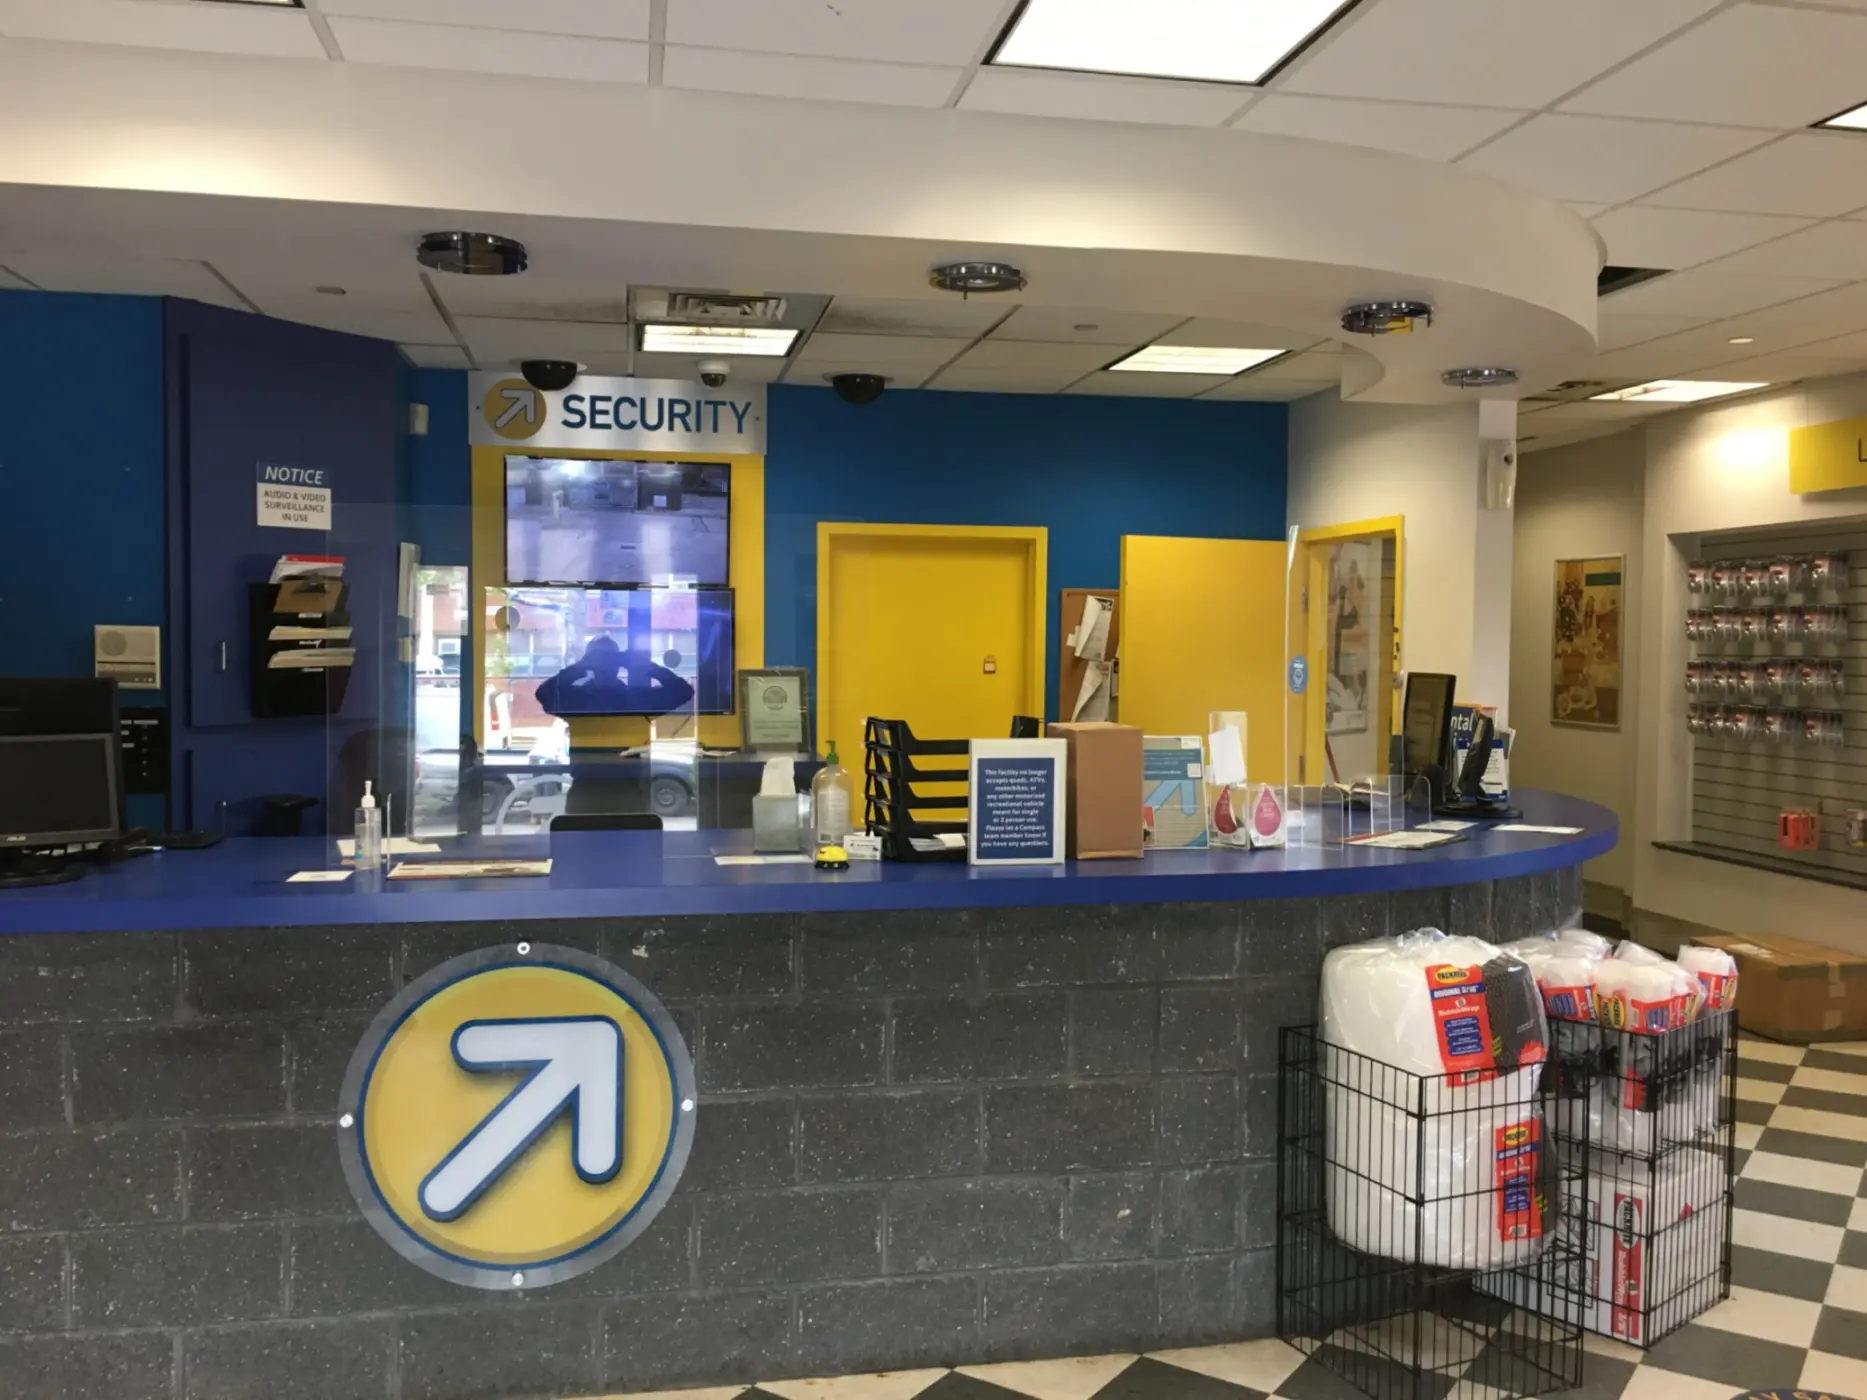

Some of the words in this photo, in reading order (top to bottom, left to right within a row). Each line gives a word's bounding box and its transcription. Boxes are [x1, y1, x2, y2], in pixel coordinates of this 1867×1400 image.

[561, 394, 752, 434] SECURITY
[264, 466, 324, 485] NOTICE
[263, 490, 291, 499] AUDIO
[293, 491, 300, 500] &
[301, 493, 326, 502] VIDEO
[264, 501, 325, 513] SURVEILLANCE
[293, 514, 308, 522] USE
[1450, 714, 1473, 731] ntal
